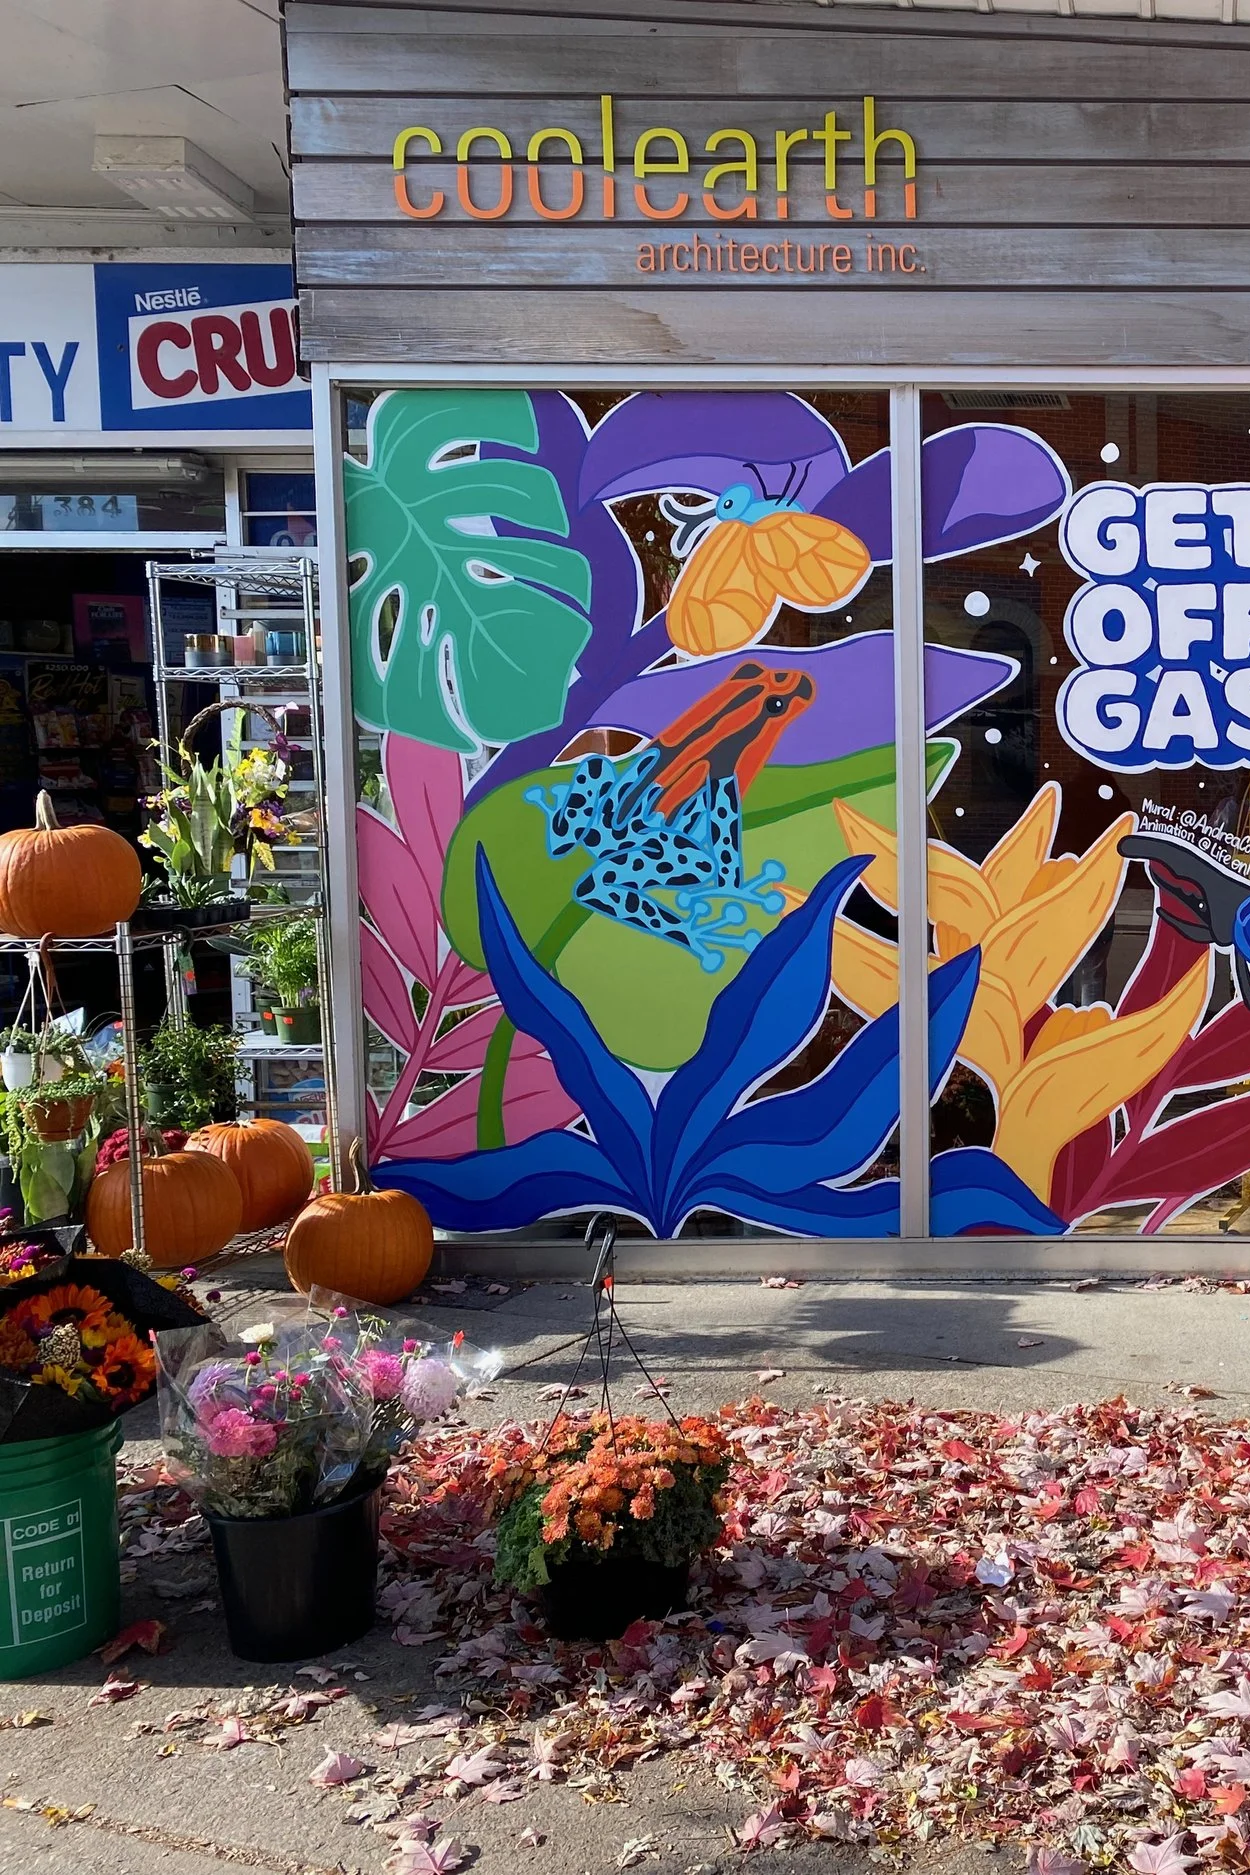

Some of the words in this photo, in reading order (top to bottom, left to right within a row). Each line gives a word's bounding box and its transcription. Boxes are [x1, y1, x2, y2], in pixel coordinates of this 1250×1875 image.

[392, 94, 917, 219] coolearth
[636, 233, 852, 272] architecture
[866, 233, 927, 272] inc.
[137, 307, 299, 399] CRU
[54, 496, 122, 518] 384
[1139, 815, 1195, 844] Animation
[12, 1519, 60, 1540] CODE
[66, 1511, 79, 1526] 01
[22, 1556, 75, 1582] Return
[39, 1582, 62, 1599] for
[21, 1594, 81, 1626] Deposit
